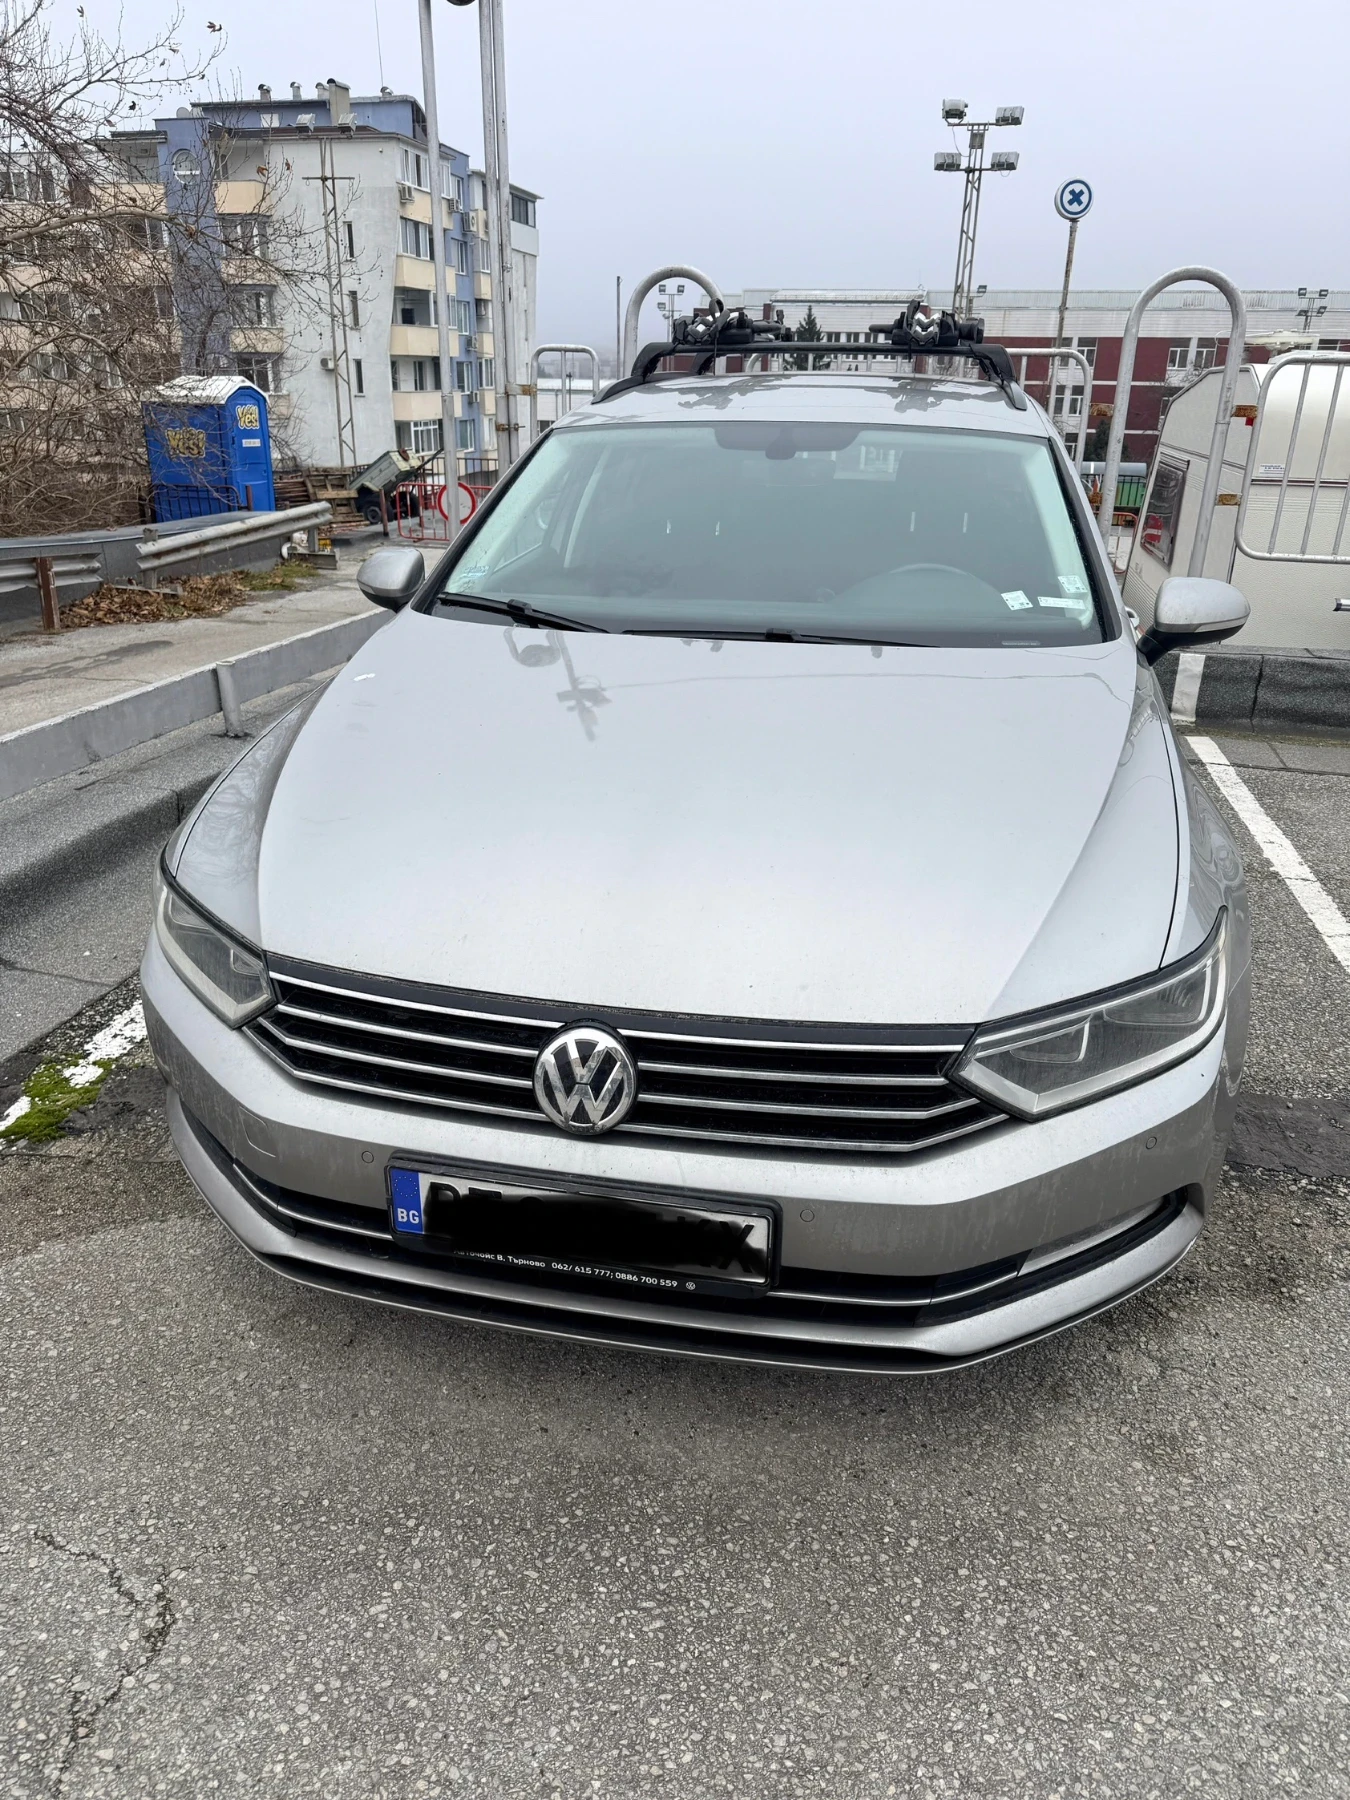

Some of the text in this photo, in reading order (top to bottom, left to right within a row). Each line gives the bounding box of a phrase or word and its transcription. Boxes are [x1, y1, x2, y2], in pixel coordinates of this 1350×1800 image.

[397, 1208, 420, 1224] BG
[507, 1255, 546, 1268] Търново
[551, 1262, 573, 1271] 062/
[574, 1265, 592, 1274] 615
[593, 1268, 614, 1279] 777;
[615, 1272, 639, 1282] 0886
[640, 1276, 658, 1285] 700
[659, 1279, 678, 1287] 559
